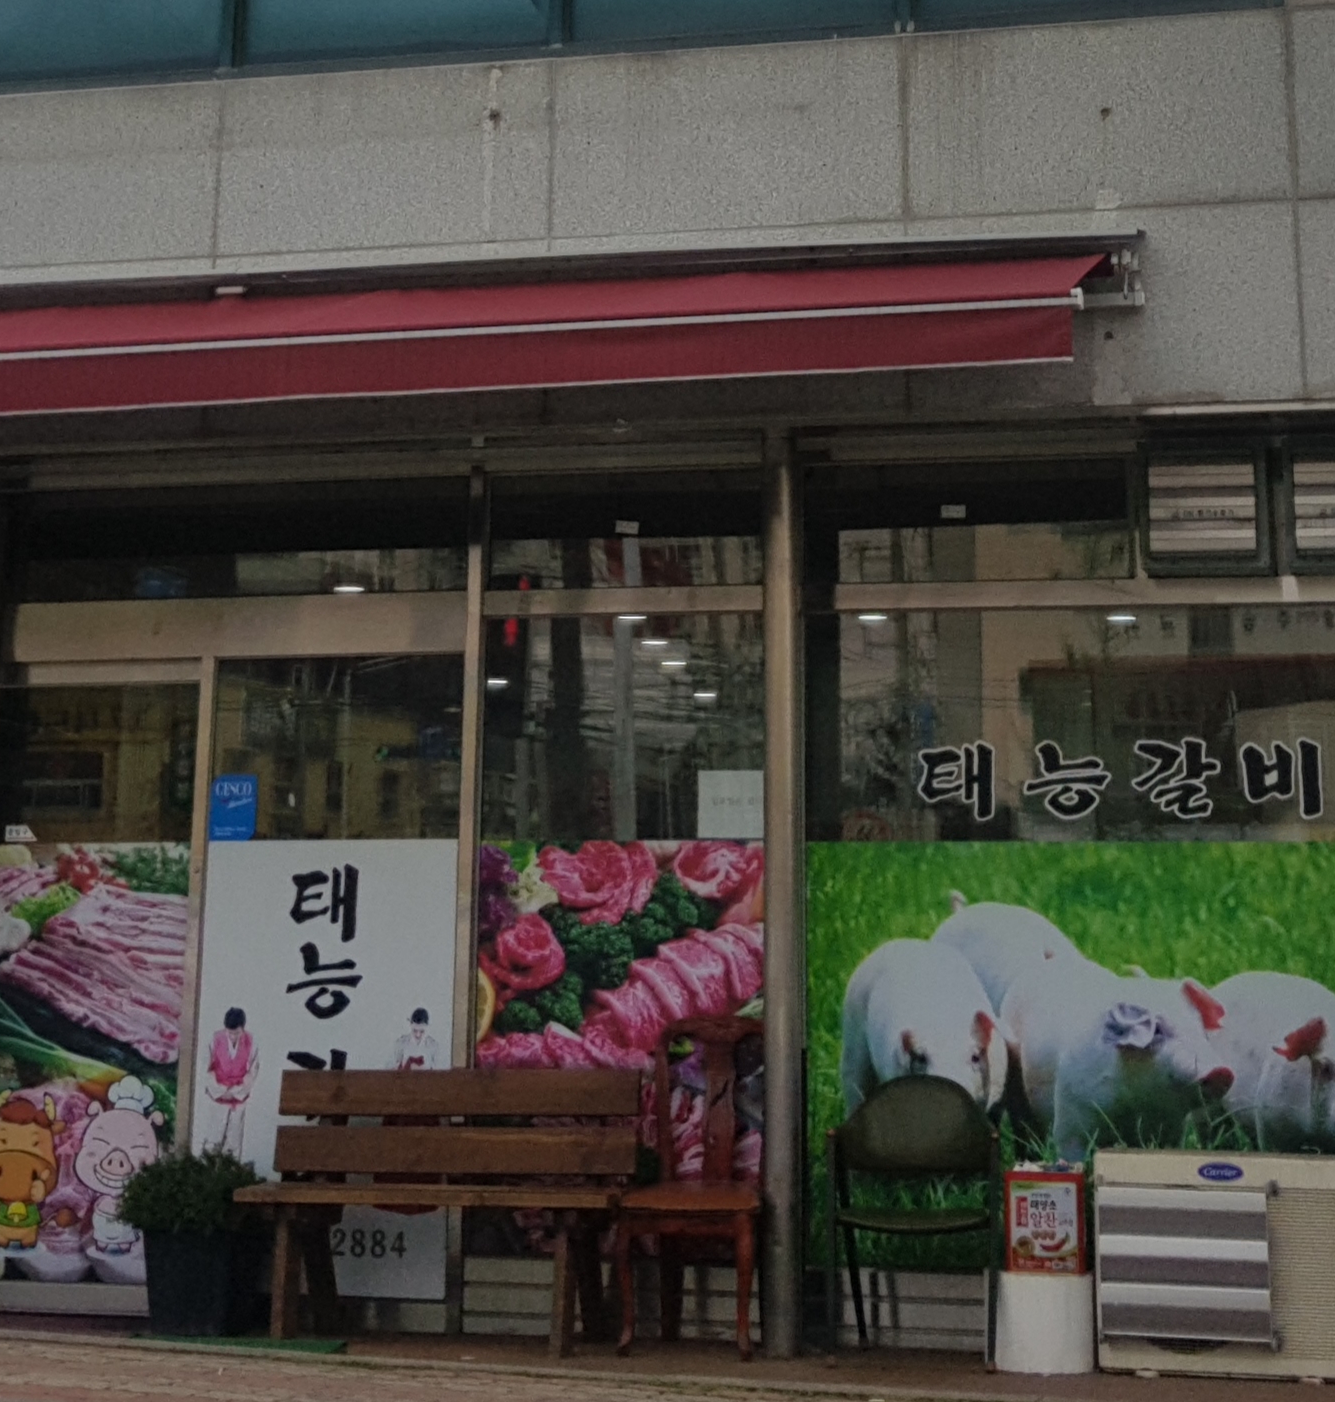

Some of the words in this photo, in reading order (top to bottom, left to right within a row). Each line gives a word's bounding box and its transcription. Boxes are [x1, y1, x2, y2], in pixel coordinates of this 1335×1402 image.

[917, 735, 1324, 821] 태능갈비
[285, 863, 363, 1070] 태능
[1203, 1166, 1238, 1177] Carrier
[330, 1228, 408, 1260] 2884
